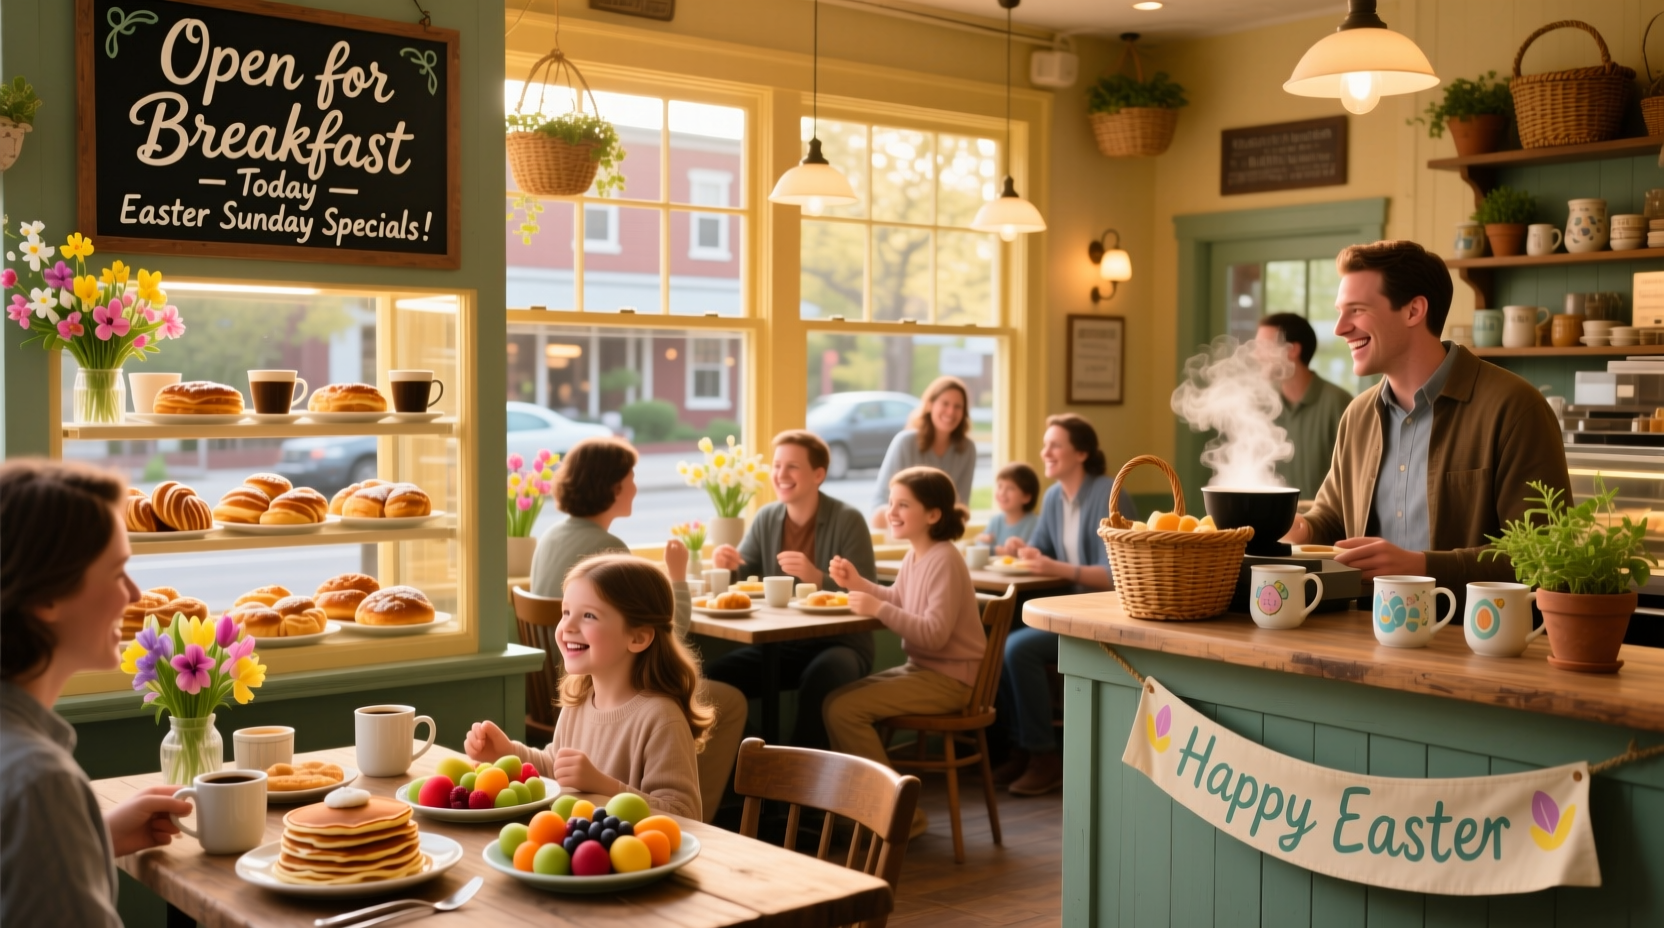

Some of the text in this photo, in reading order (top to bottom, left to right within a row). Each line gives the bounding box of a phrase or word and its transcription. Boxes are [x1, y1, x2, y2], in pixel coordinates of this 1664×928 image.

[160, 18, 395, 111] Open for
[128, 91, 415, 181] Breakfast
[119, 193, 433, 247] Easter Sunday Specials!
[236, 167, 317, 211] Today
[1176, 725, 1511, 864] Happy Easter
